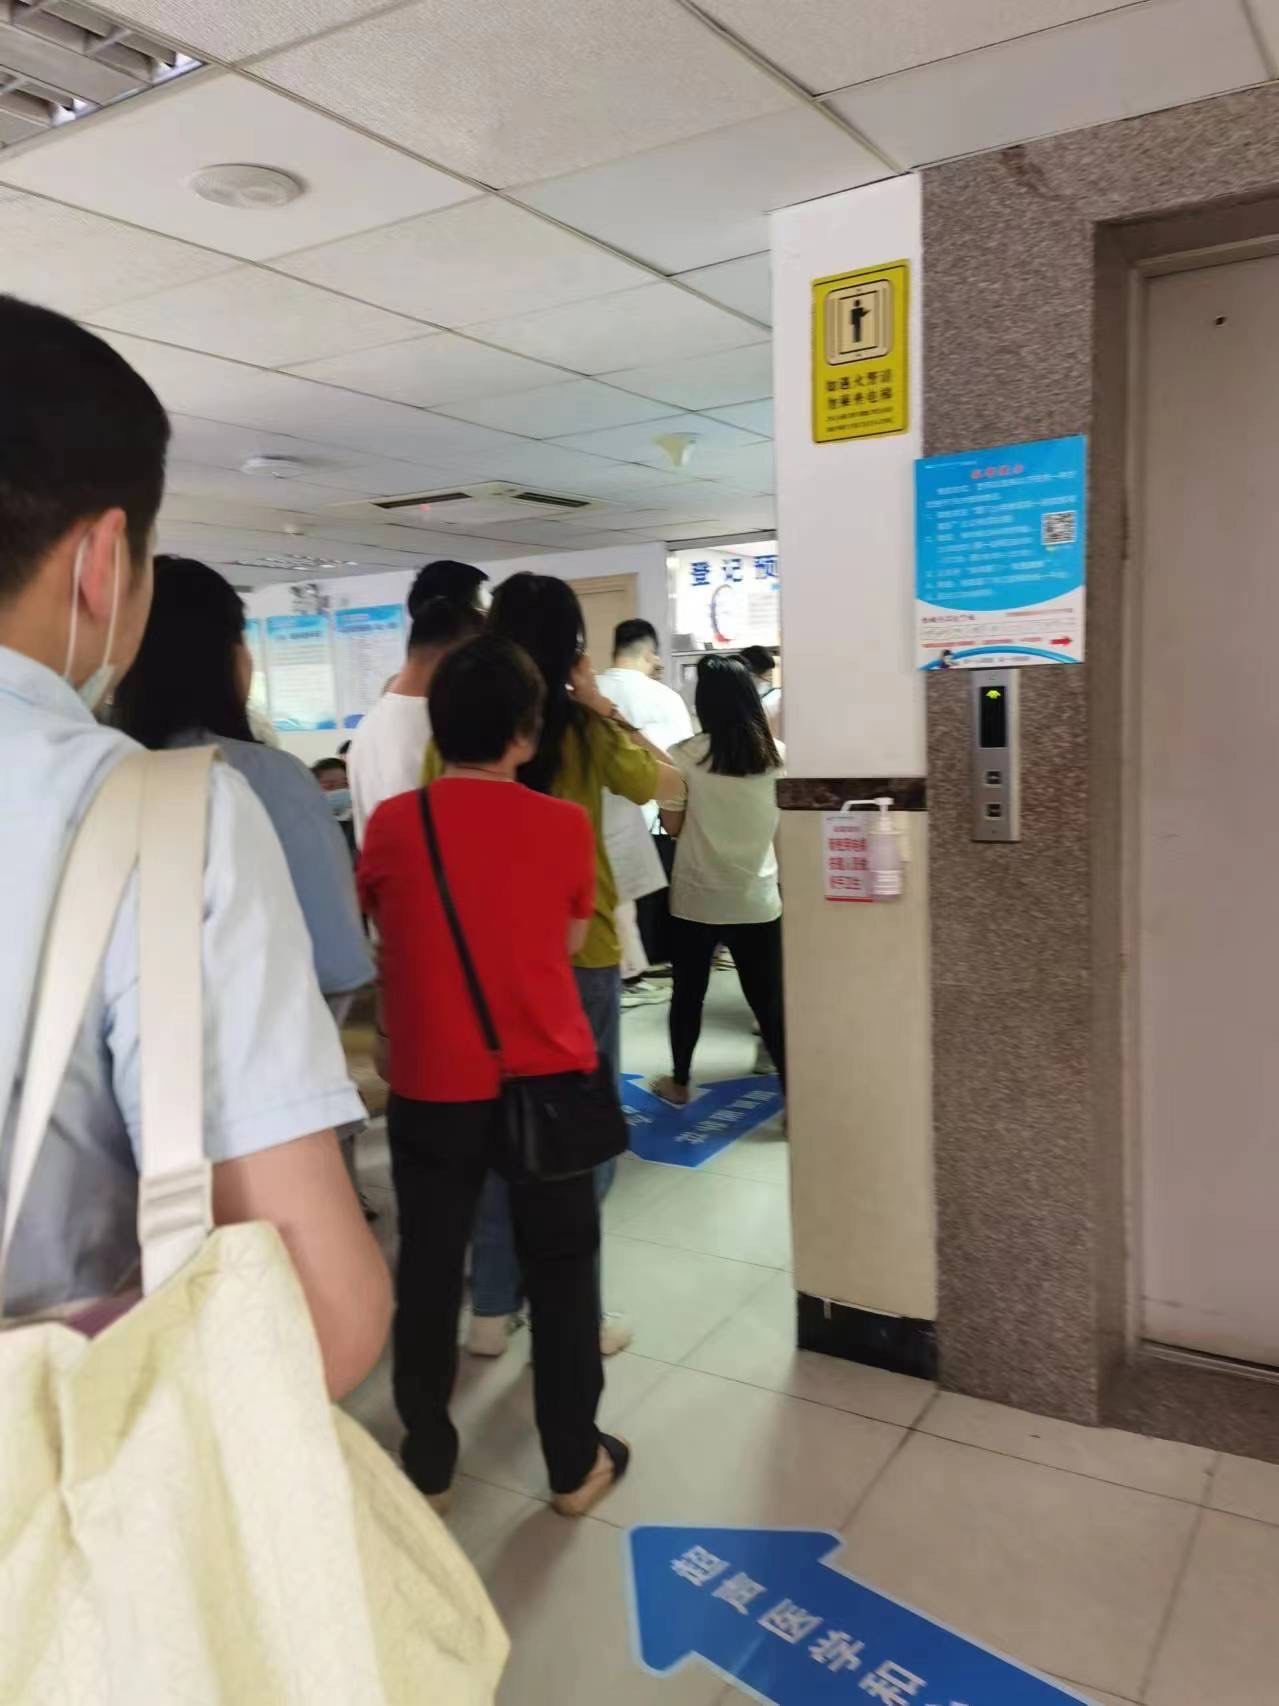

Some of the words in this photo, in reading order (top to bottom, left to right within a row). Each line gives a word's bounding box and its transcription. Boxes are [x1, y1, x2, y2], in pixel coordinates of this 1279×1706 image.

[670, 1544, 969, 1706] 超声医学和
